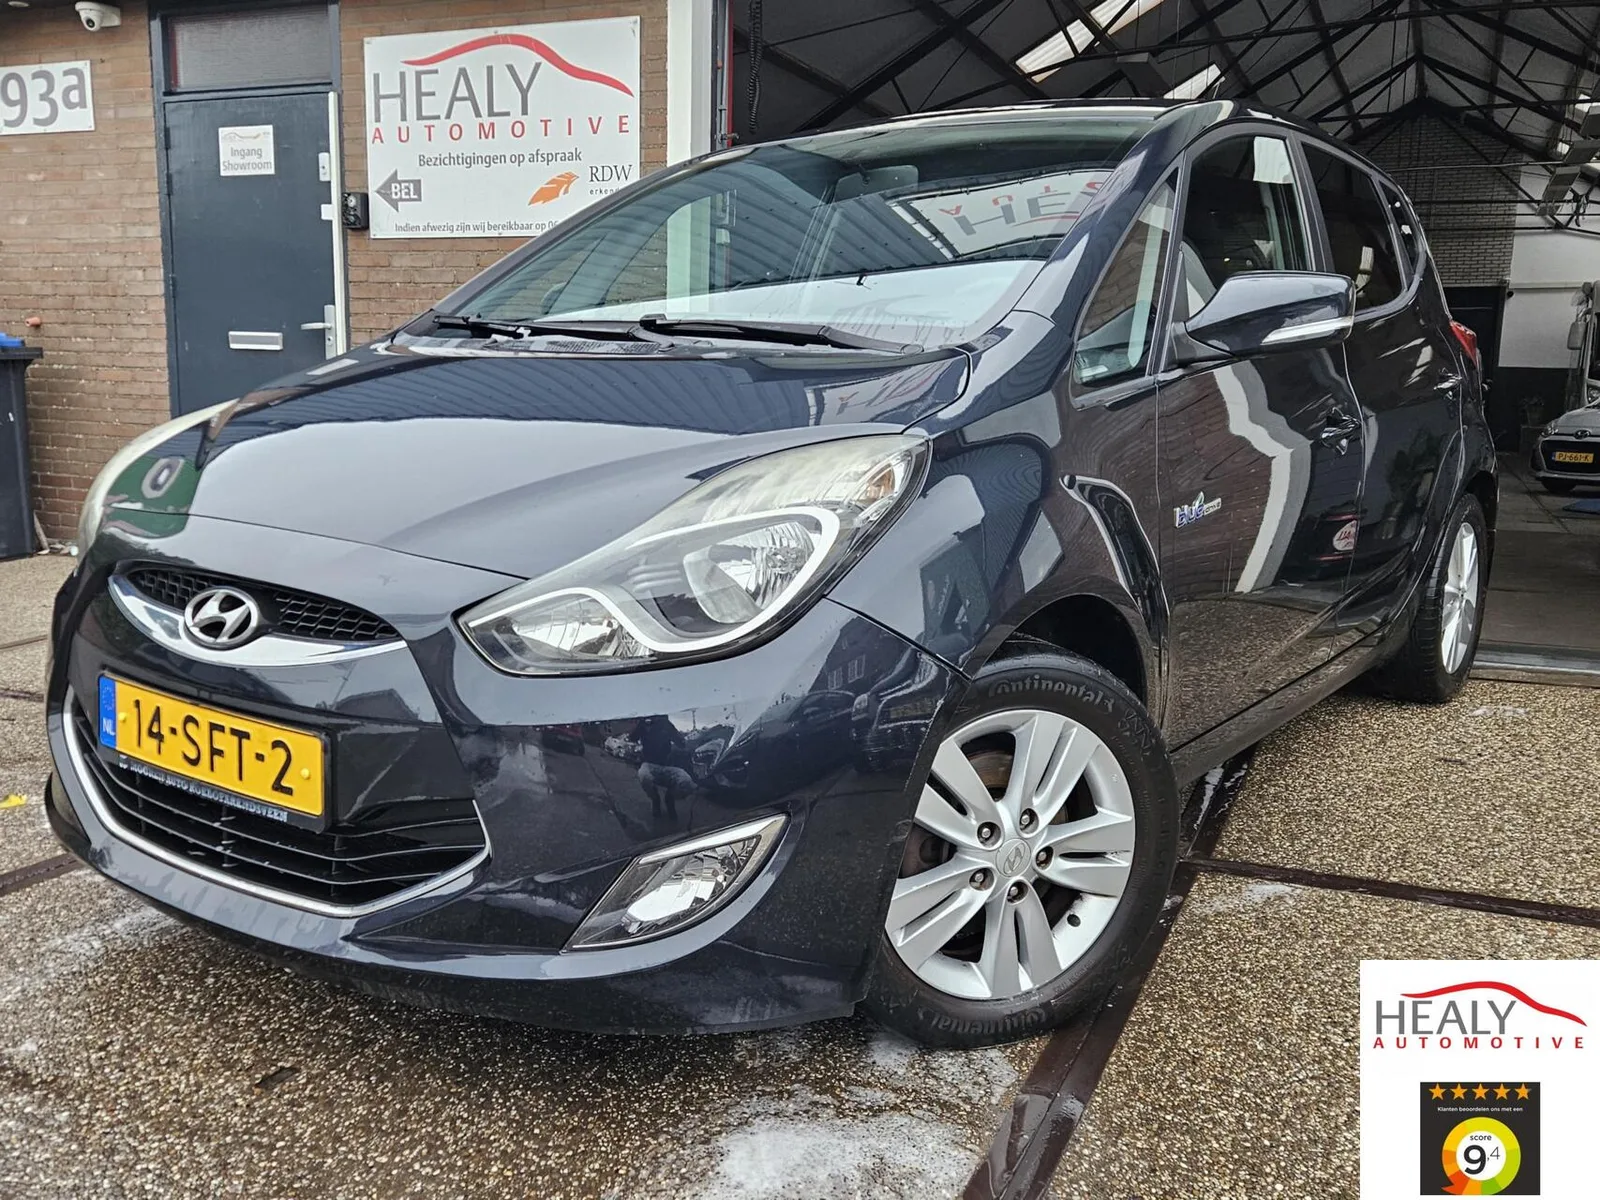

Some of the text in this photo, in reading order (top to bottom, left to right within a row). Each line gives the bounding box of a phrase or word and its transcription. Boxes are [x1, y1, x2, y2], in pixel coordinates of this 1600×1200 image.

[1, 67, 87, 128] 93a
[373, 62, 542, 123] HEALY
[372, 115, 630, 144] AUTOMOTIVE
[230, 147, 263, 160] Ingang
[418, 147, 583, 169] Bezichtigingen op afspraak
[222, 160, 273, 172] Showroom
[589, 164, 633, 182] RDW
[390, 182, 418, 200] BEL
[395, 223, 421, 233] Indien
[422, 222, 454, 235] afwezig
[455, 222, 471, 234] zijn
[472, 221, 486, 233] wij
[487, 220, 534, 232] bereikbaar
[535, 222, 547, 233] op
[988, 673, 1104, 707] Continental
[102, 717, 115, 736] NL
[133, 698, 294, 797] 14-SFT-2
